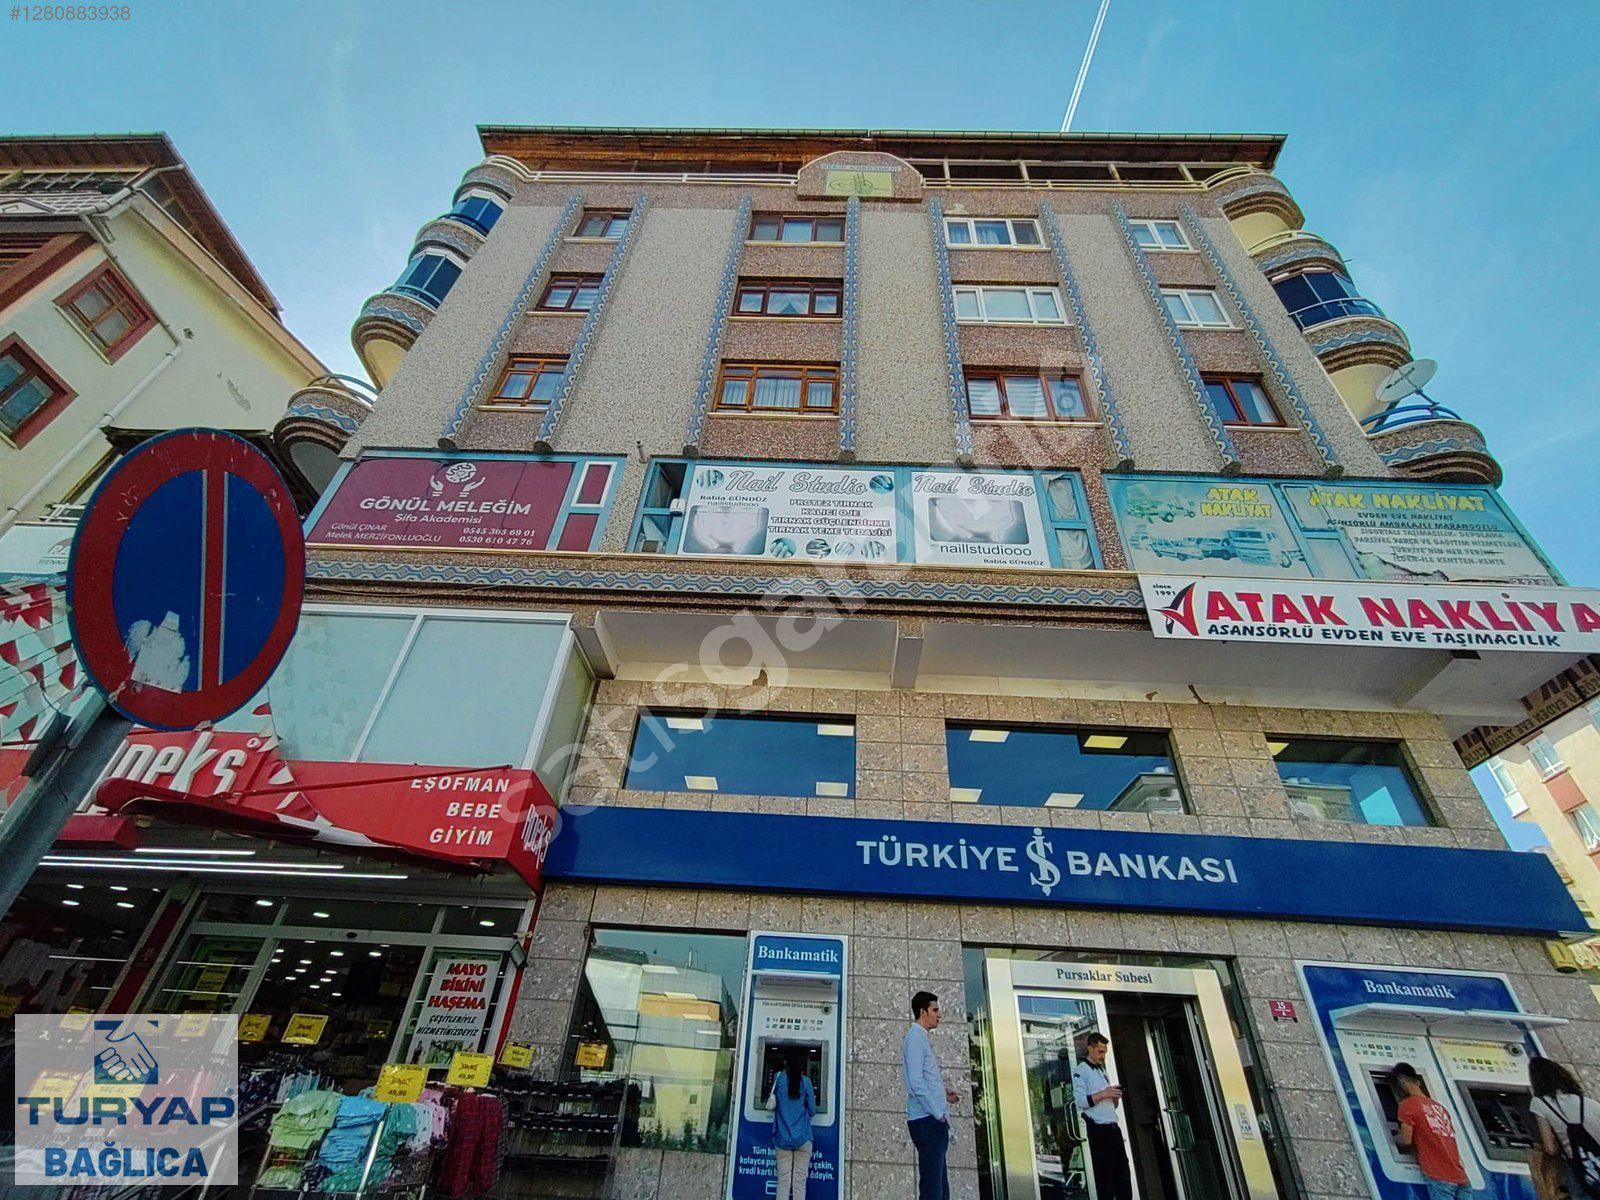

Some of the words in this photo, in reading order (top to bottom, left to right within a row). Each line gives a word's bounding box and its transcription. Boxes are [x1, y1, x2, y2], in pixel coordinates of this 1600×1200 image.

[725, 470, 785, 492] Nail
[789, 471, 868, 495] Studio
[914, 475, 962, 494] Nail
[968, 476, 1035, 497] Studio
[1206, 487, 1258, 503] ATAK
[1308, 491, 1367, 509] ATAK
[360, 496, 430, 512] GÖNÜL
[436, 499, 532, 515] MELEĞİM
[833, 500, 873, 508] TIRNAK
[394, 513, 418, 522] Şifa
[421, 514, 483, 524] Akademisi
[801, 508, 837, 516] KALICI
[838, 509, 861, 517] OJE
[331, 522, 356, 530] Gönül
[771, 517, 812, 525] TIRNAK
[813, 517, 891, 527] GÜÇLENDİRME
[325, 531, 353, 539] Melek
[463, 527, 487, 535] 0545
[768, 526, 811, 534] TIRNAK
[811, 527, 842, 535] YEME
[485, 536, 504, 544] 610
[519, 538, 533, 546] 76
[940, 544, 1032, 556] naillstudiooo
[1206, 591, 1348, 626] ATAK
[1208, 623, 1313, 639] ASANSÖRLÜ
[1321, 628, 1383, 641] EVDEN
[1391, 631, 1427, 643] EVE
[1432, 632, 1561, 647] TAŞIMACILIK
[411, 776, 510, 794] EŞOFMAN
[446, 801, 503, 820] BEBE
[429, 827, 494, 847] GİYİM
[856, 834, 1020, 873] TÜRKİYE
[1067, 850, 1239, 884] BANKASI
[757, 945, 840, 963] Bankamatik
[446, 962, 488, 976] MAYO
[1056, 968, 1112, 982] Pursaklar
[439, 976, 486, 993] BİKİNİ
[1363, 979, 1456, 1000] Bankamatik
[428, 995, 486, 1011] HAŞEMA
[752, 1146, 767, 1155] Tüm
[739, 1165, 757, 1175] kredi
